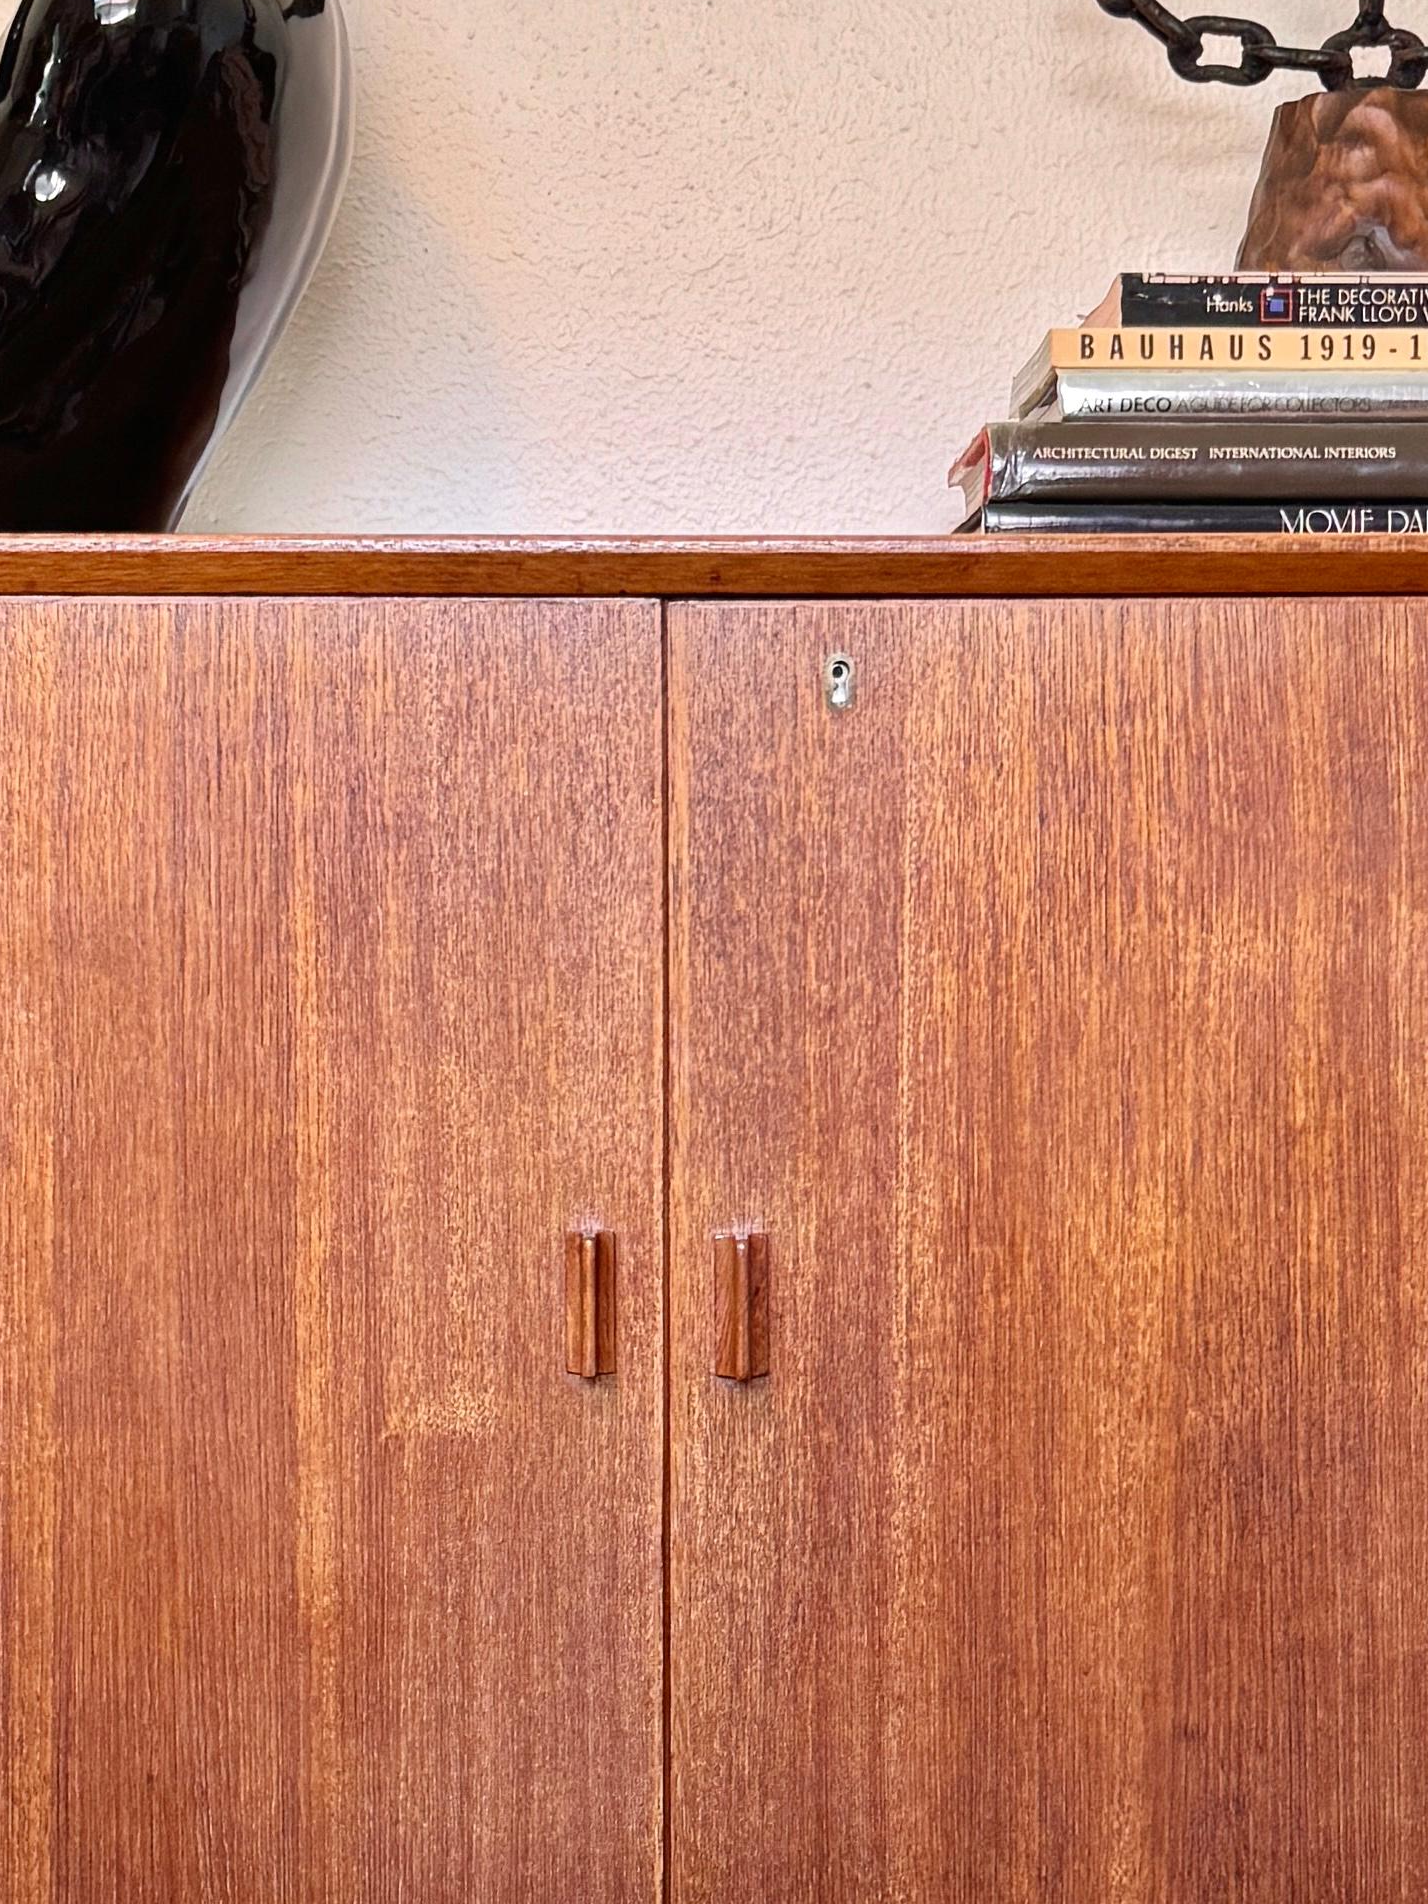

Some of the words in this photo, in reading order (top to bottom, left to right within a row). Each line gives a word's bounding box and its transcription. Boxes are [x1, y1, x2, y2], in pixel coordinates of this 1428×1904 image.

[1205, 297, 1254, 314] Hanks
[1297, 288, 1332, 306] THE
[1297, 306, 1356, 324] FRANK
[1361, 306, 1418, 323] LLOYD
[1079, 333, 1273, 362] BAUHAUS
[1078, 397, 1114, 414] ART
[1119, 397, 1173, 413] DECO
[1176, 397, 1190, 413] A
[1191, 396, 1237, 414] GUIDE
[1240, 397, 1271, 413] FOR
[1274, 396, 1372, 413] COLLECTORS
[1032, 447, 1147, 460] ARCHITECTURAL
[1149, 447, 1199, 460] DIGEST
[1208, 447, 1322, 460] INTERNATIONAL
[1324, 446, 1397, 460] INTERIORS
